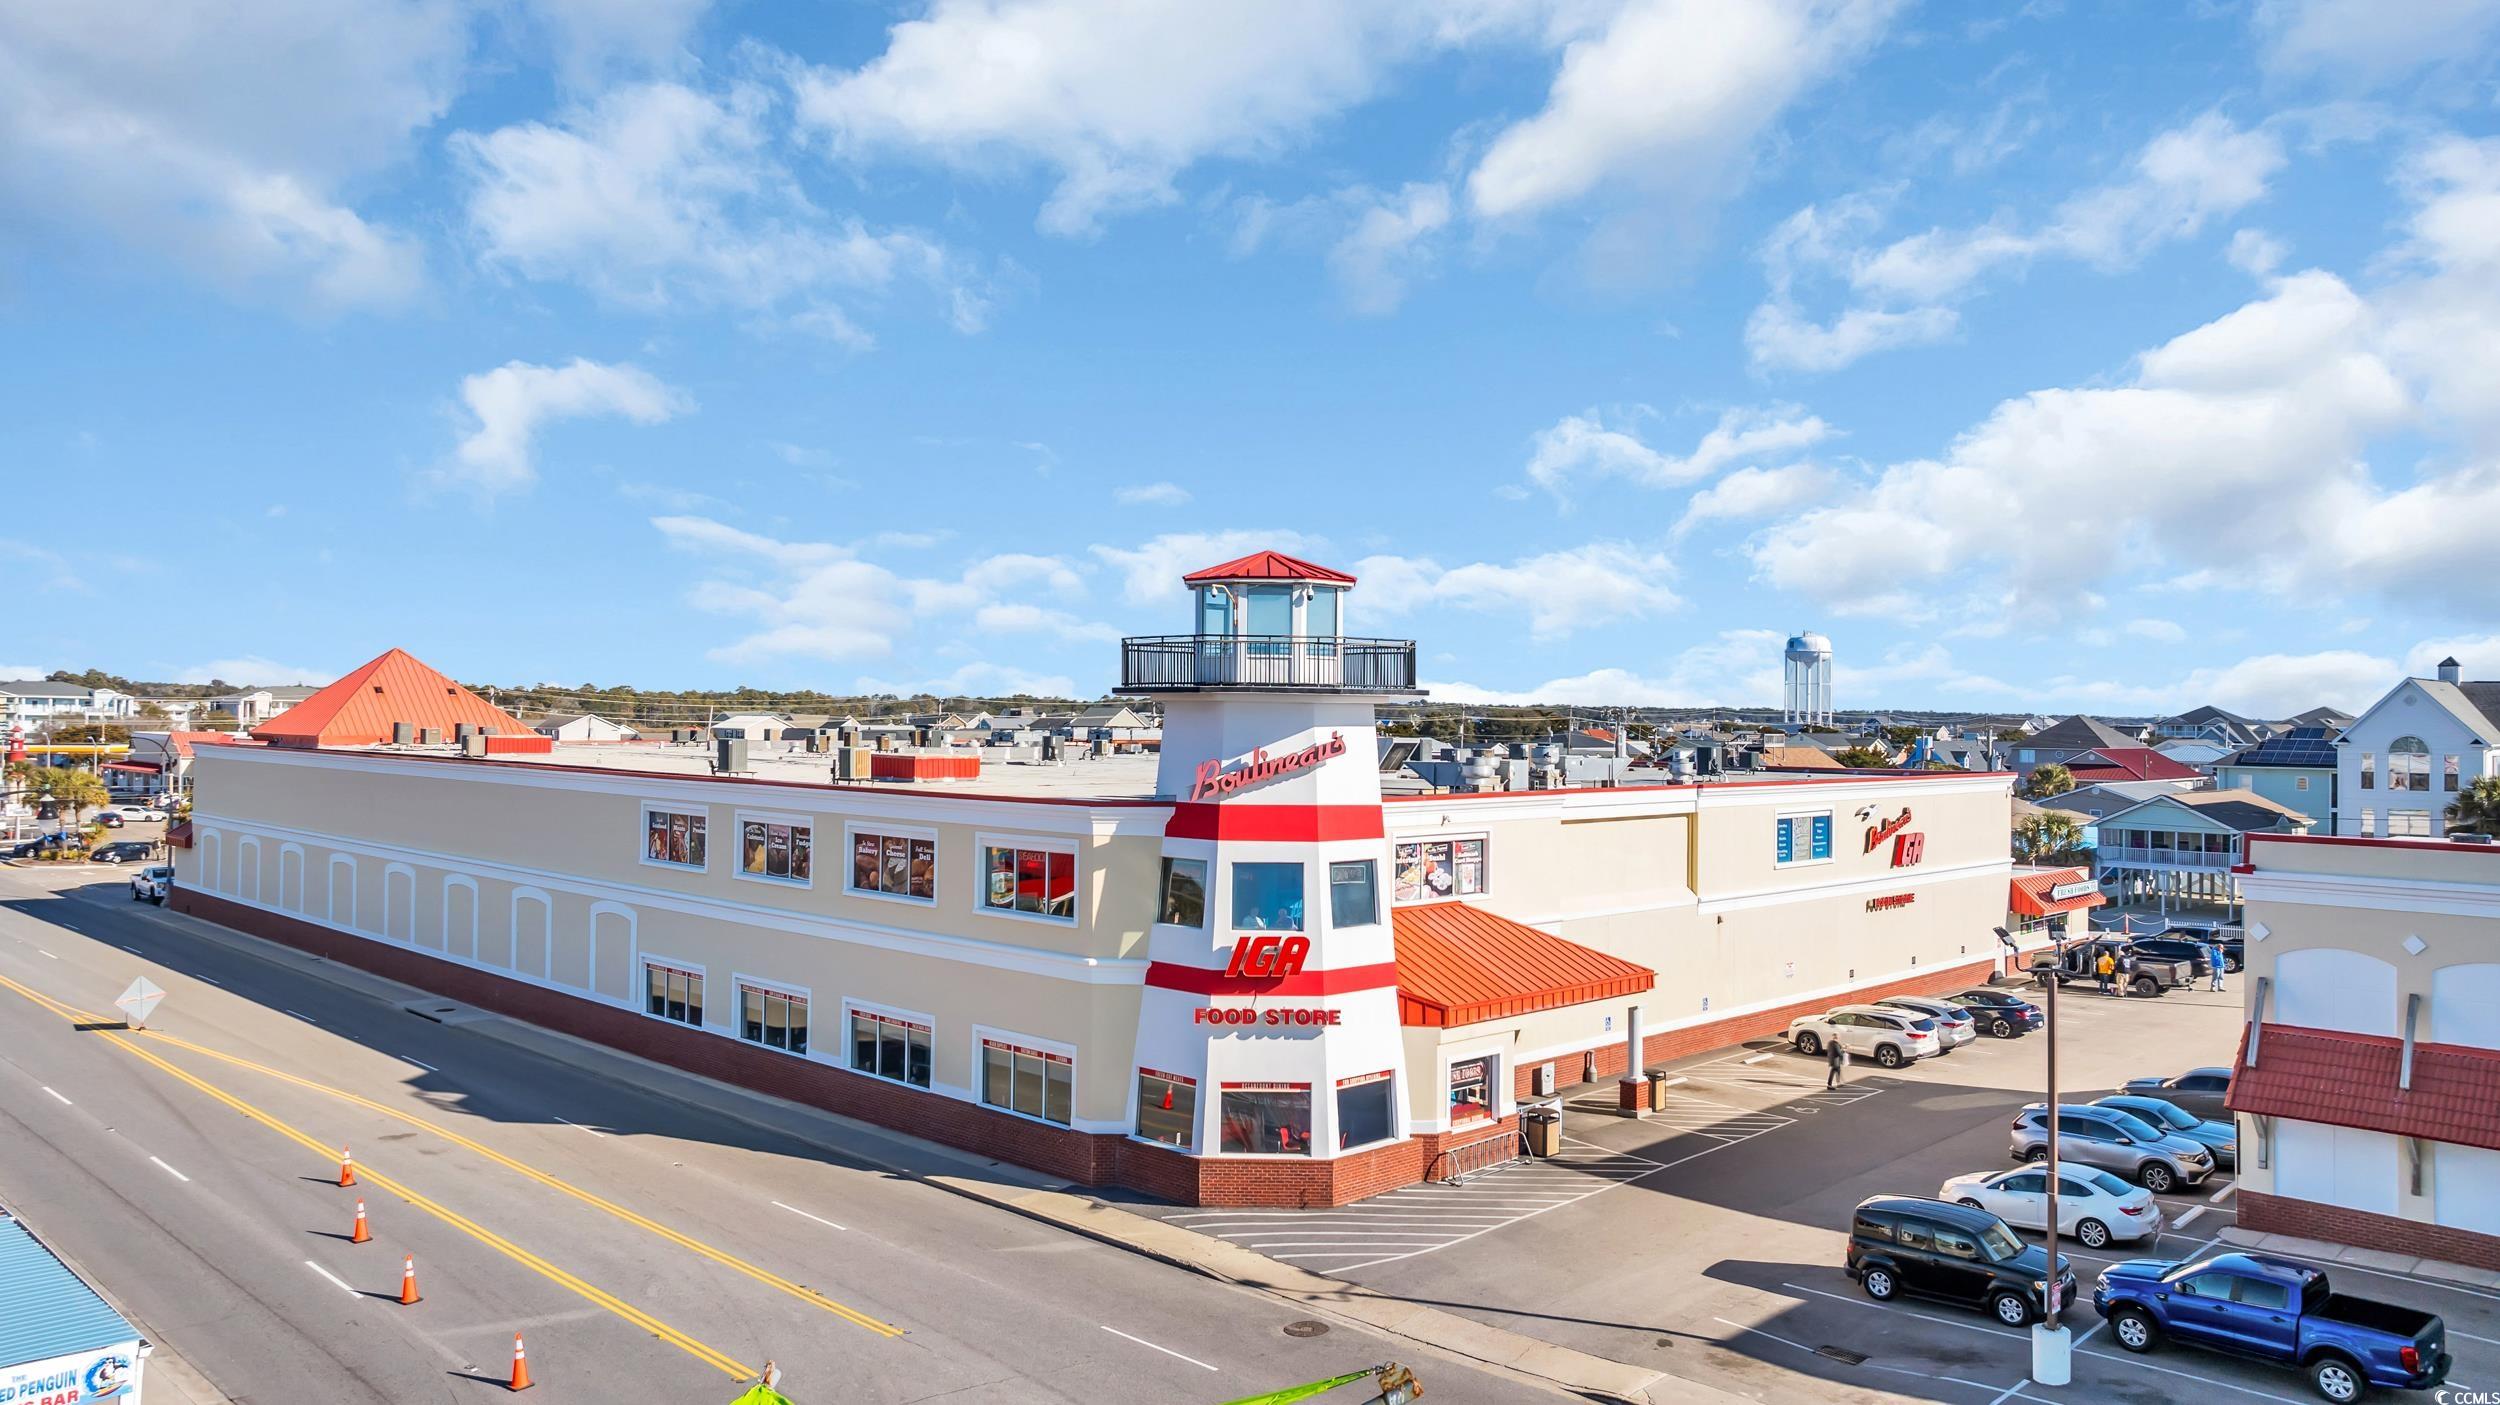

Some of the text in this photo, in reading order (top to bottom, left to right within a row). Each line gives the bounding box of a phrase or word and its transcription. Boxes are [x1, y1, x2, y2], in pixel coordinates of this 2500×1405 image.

[1190, 731, 1347, 802] Boulineau's
[886, 850, 906, 858] Cheese
[1894, 832, 1925, 867] IGA
[1224, 936, 1311, 977] IGA
[1194, 1007, 1341, 1026] FOOD STORE
[0, 1369, 78, 1403] ED PENGUIN
[40, 1389, 79, 1405] BAR
